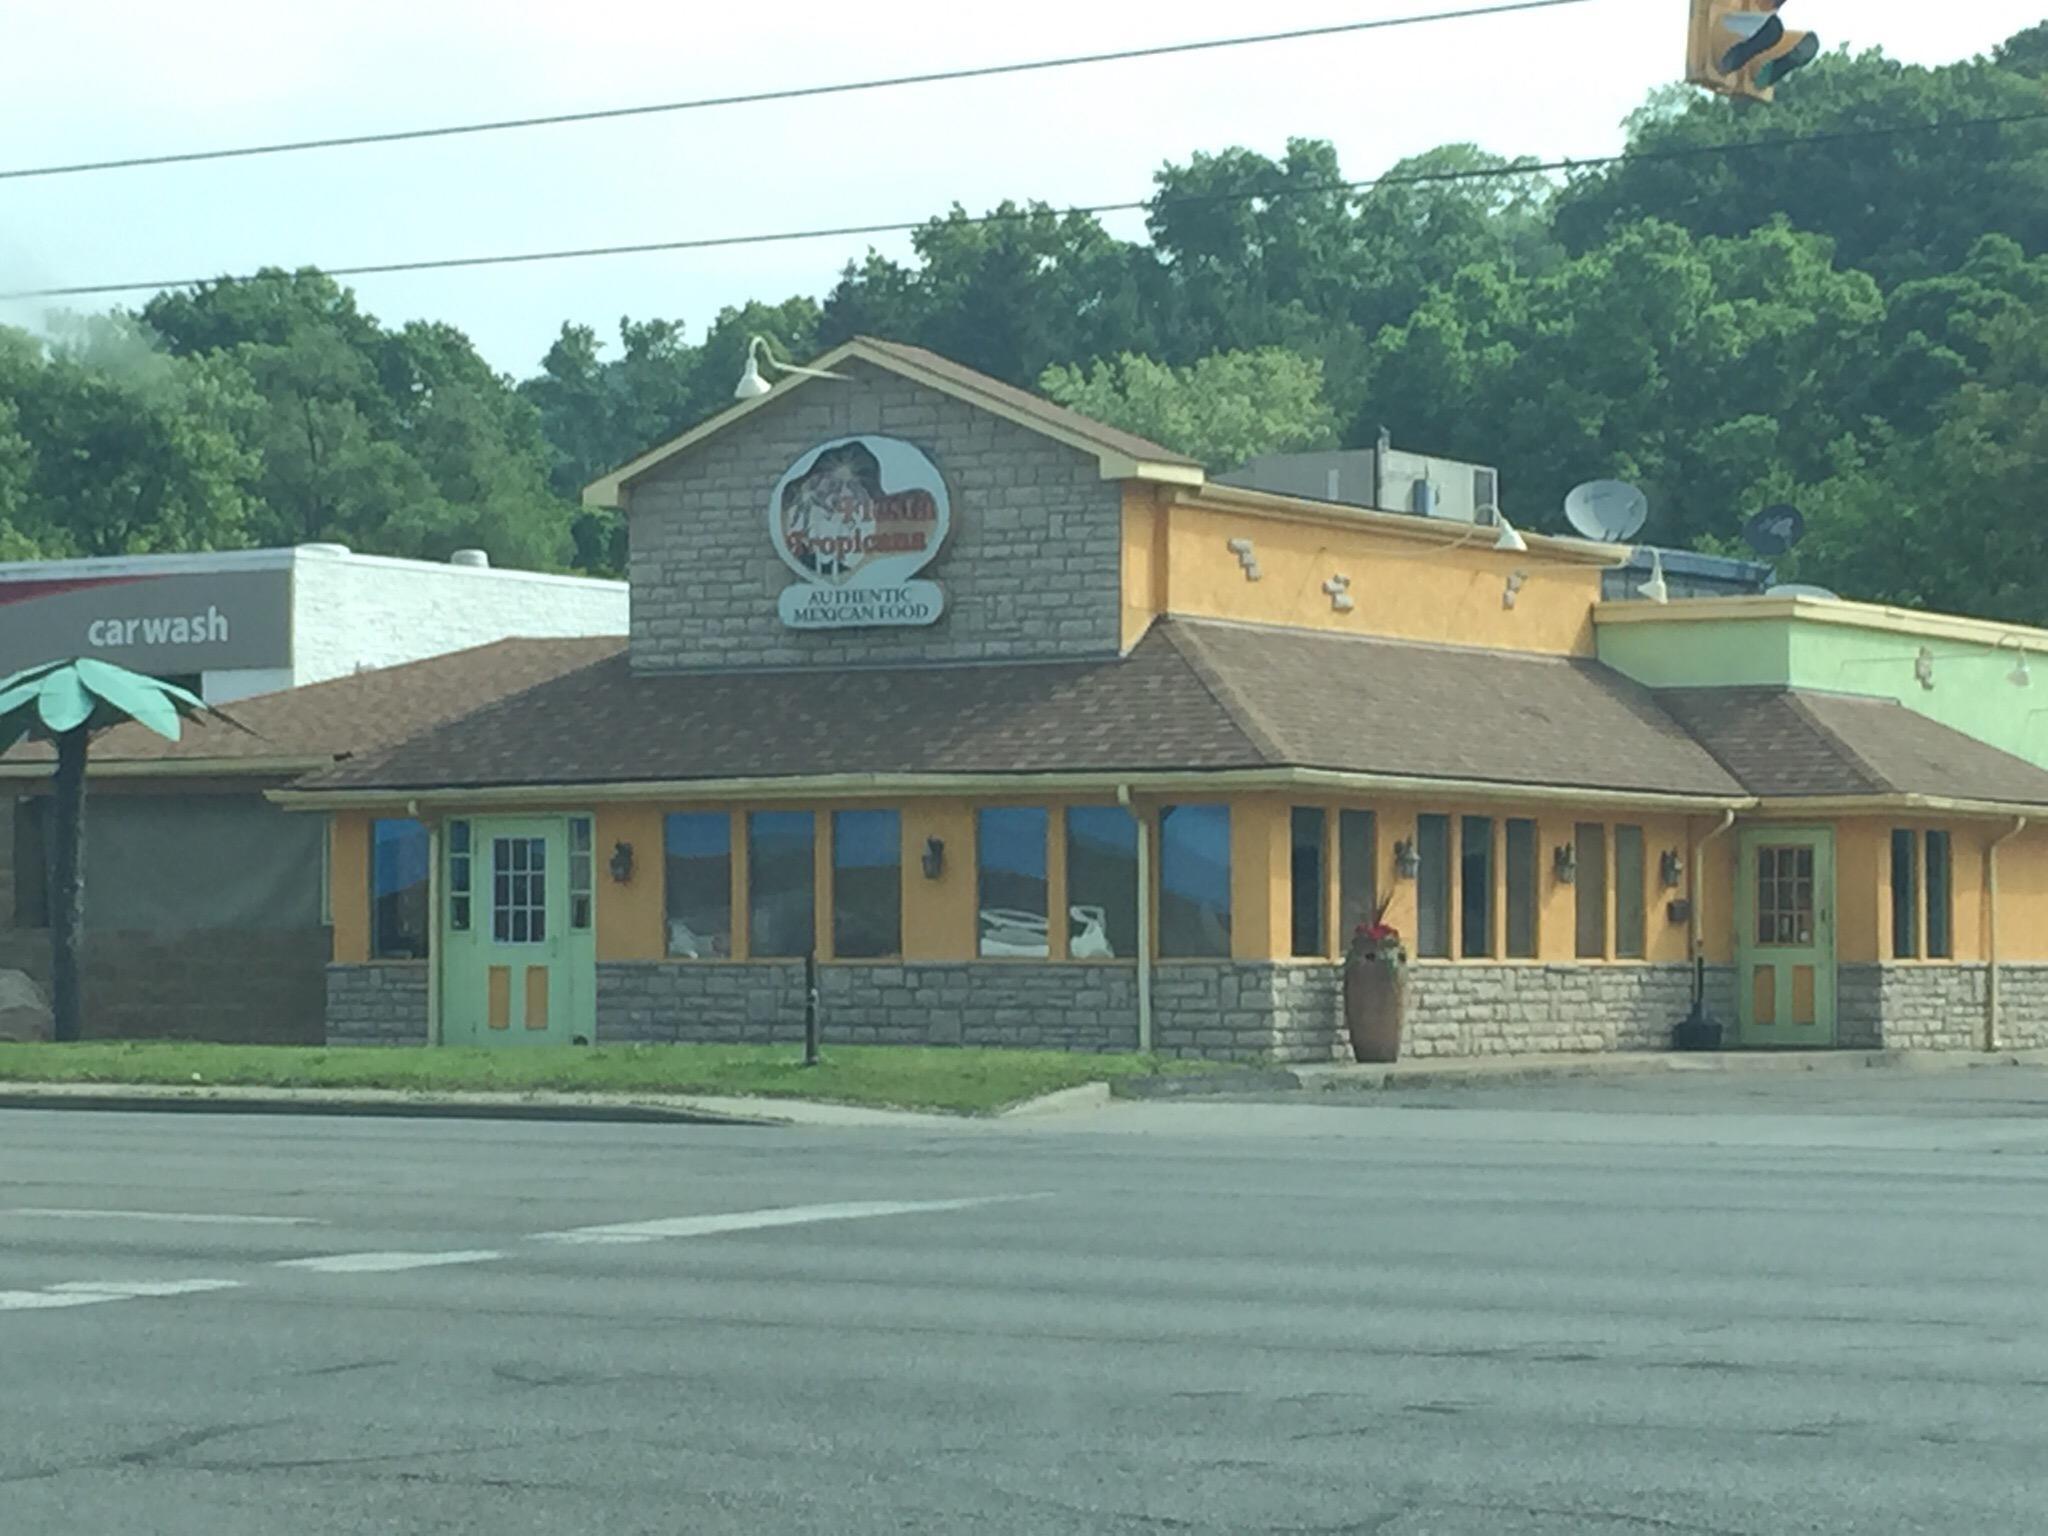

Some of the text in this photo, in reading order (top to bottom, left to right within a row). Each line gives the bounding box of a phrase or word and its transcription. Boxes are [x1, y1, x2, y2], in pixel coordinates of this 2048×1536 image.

[808, 587, 914, 605] AUTHENTIC
[793, 603, 929, 622] MEXICAN FOOD
